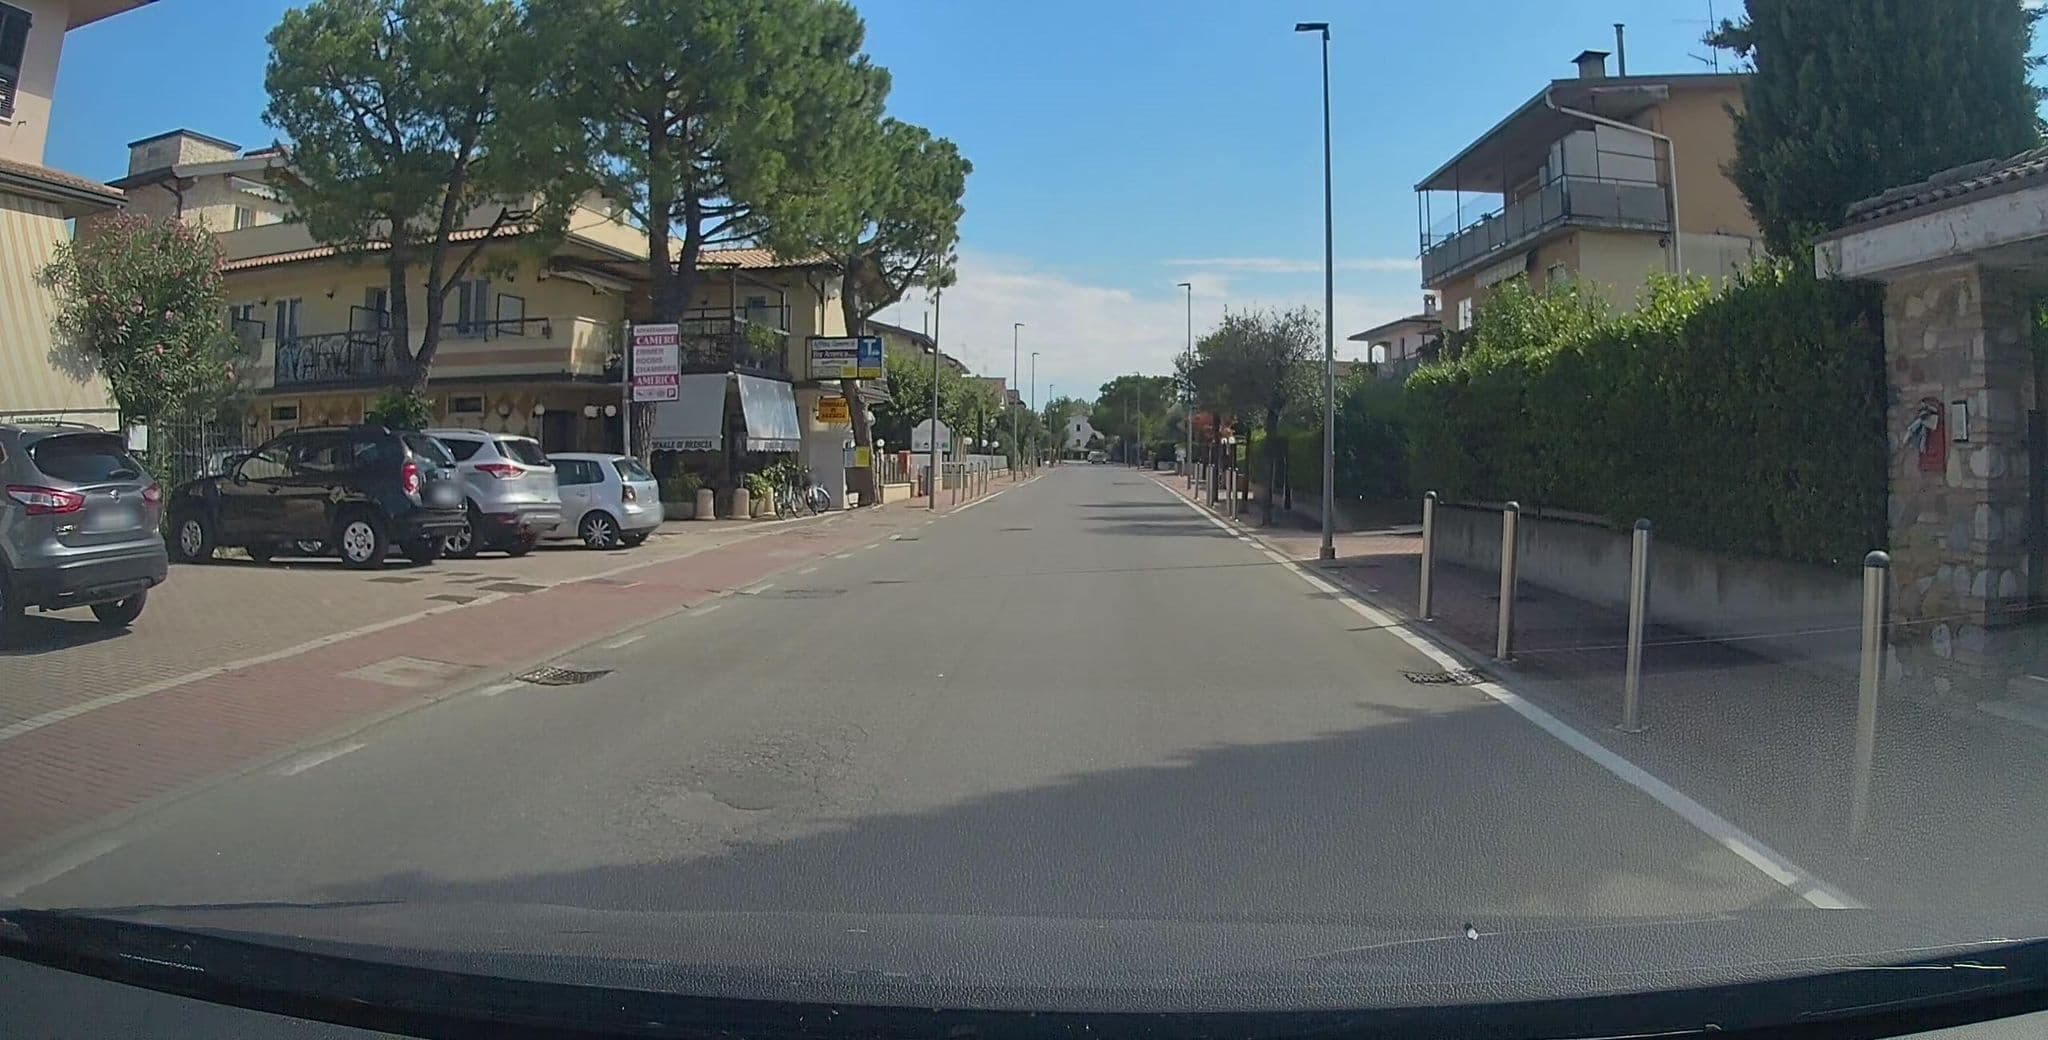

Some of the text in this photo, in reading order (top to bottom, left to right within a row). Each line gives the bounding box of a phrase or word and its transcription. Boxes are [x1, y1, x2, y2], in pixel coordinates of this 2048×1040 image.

[636, 335, 677, 345] CAMERE
[637, 375, 677, 385] AMERICA
[684, 440, 713, 448] BRESCIA
